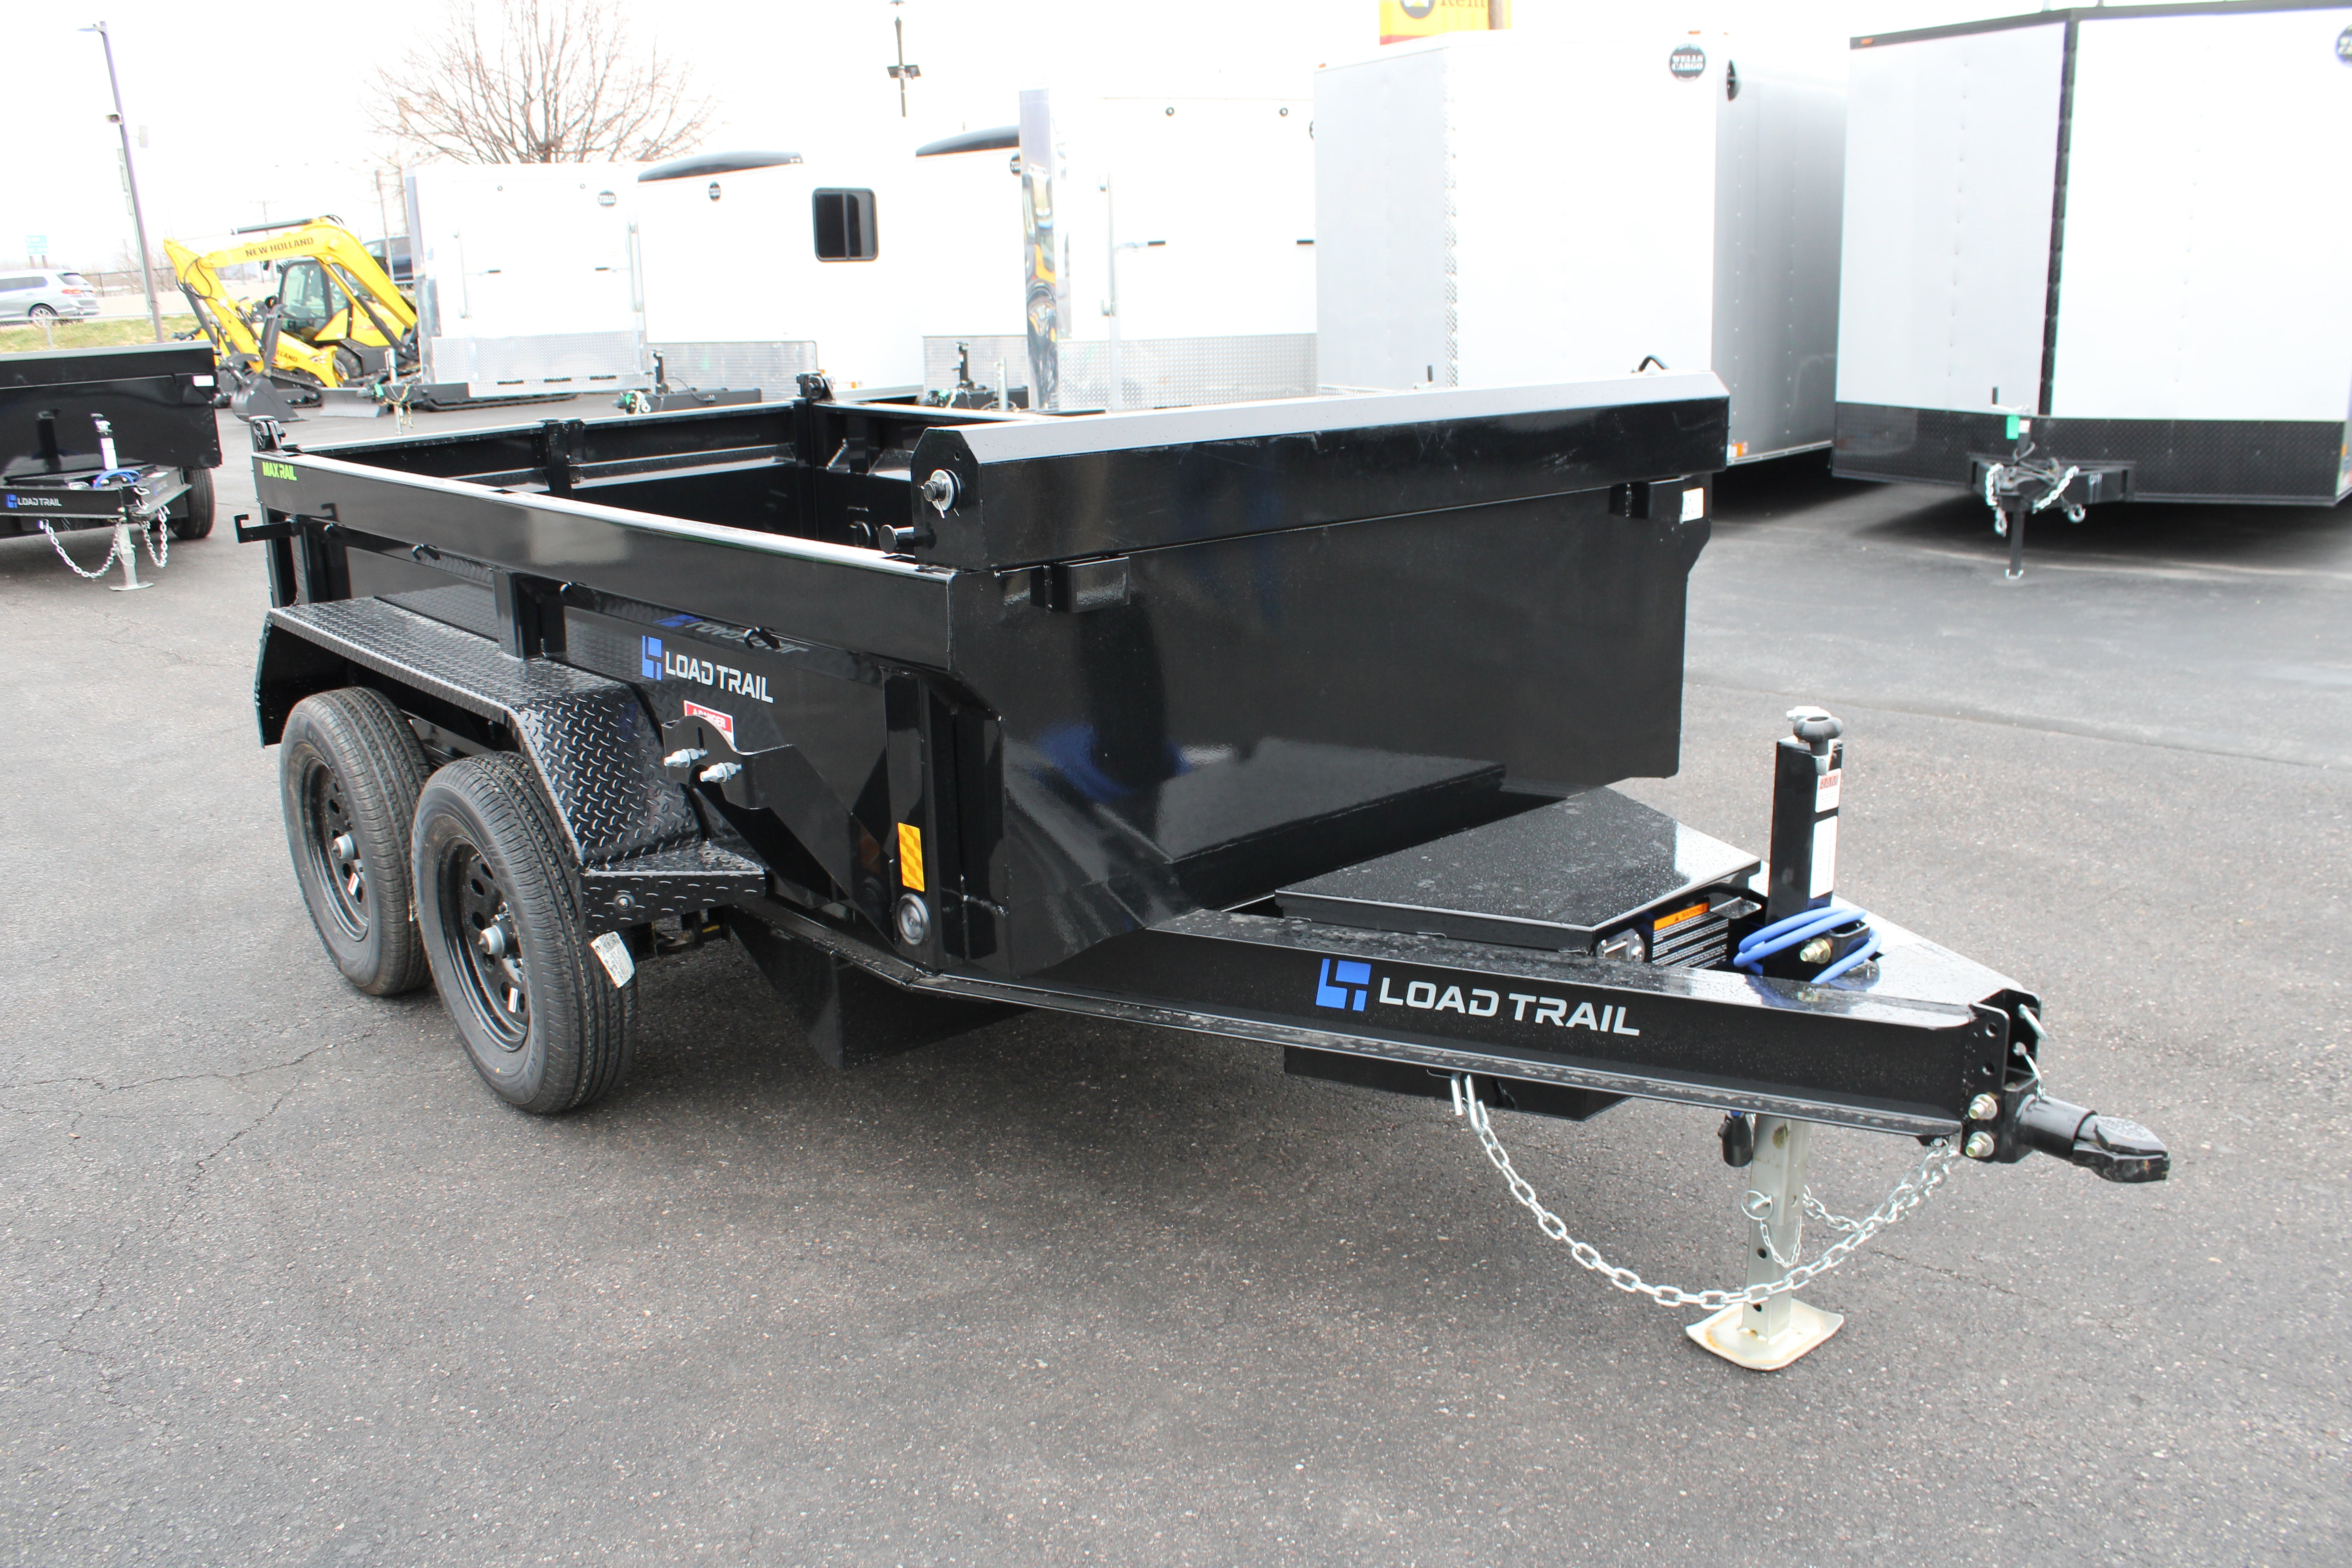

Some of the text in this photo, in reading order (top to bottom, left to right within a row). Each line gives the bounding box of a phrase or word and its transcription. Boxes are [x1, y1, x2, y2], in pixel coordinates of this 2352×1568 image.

[1672, 54, 1704, 62] WELLS
[1671, 62, 1704, 71] CARGO
[245, 237, 314, 257] NEW HOLLAND
[277, 350, 298, 362] LLAND
[262, 461, 298, 481] MAX RAIL
[17, 497, 62, 506] LOAD TRAIL
[665, 650, 774, 704] LOAD TRAIL
[1682, 905, 1705, 919] WARNING
[1379, 977, 1640, 1036] LOAD TRAIL
